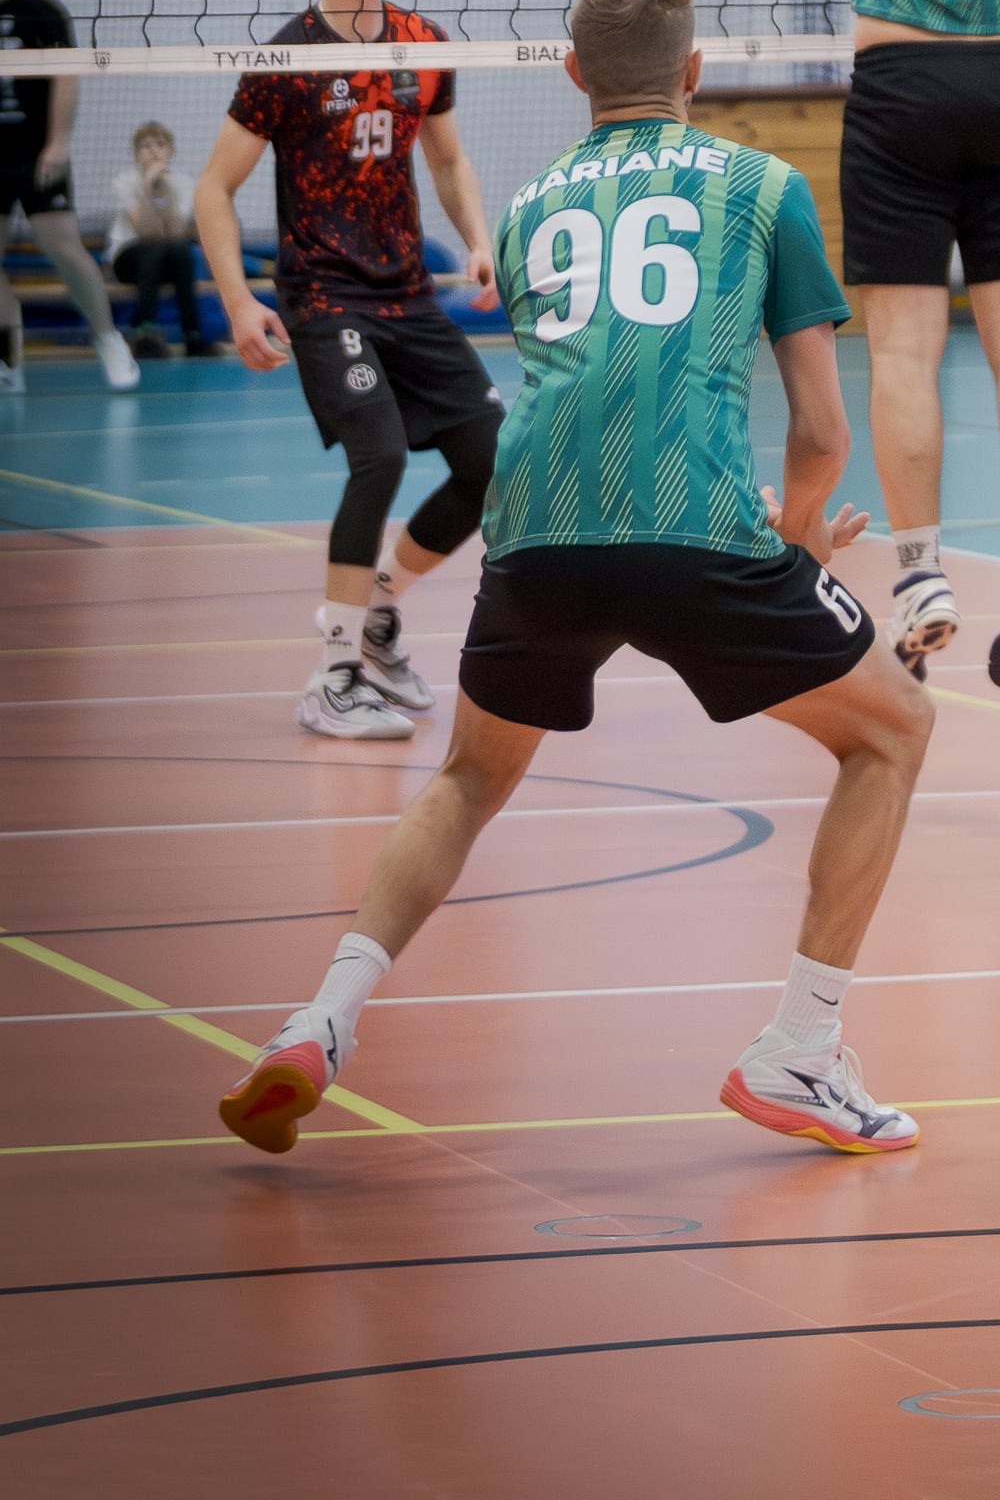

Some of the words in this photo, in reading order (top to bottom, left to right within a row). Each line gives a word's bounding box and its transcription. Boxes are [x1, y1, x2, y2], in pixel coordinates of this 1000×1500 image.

[213, 50, 291, 68] TYTANI
[351, 108, 394, 159] 99
[510, 145, 729, 219] MARIANE
[526, 194, 702, 343] 96
